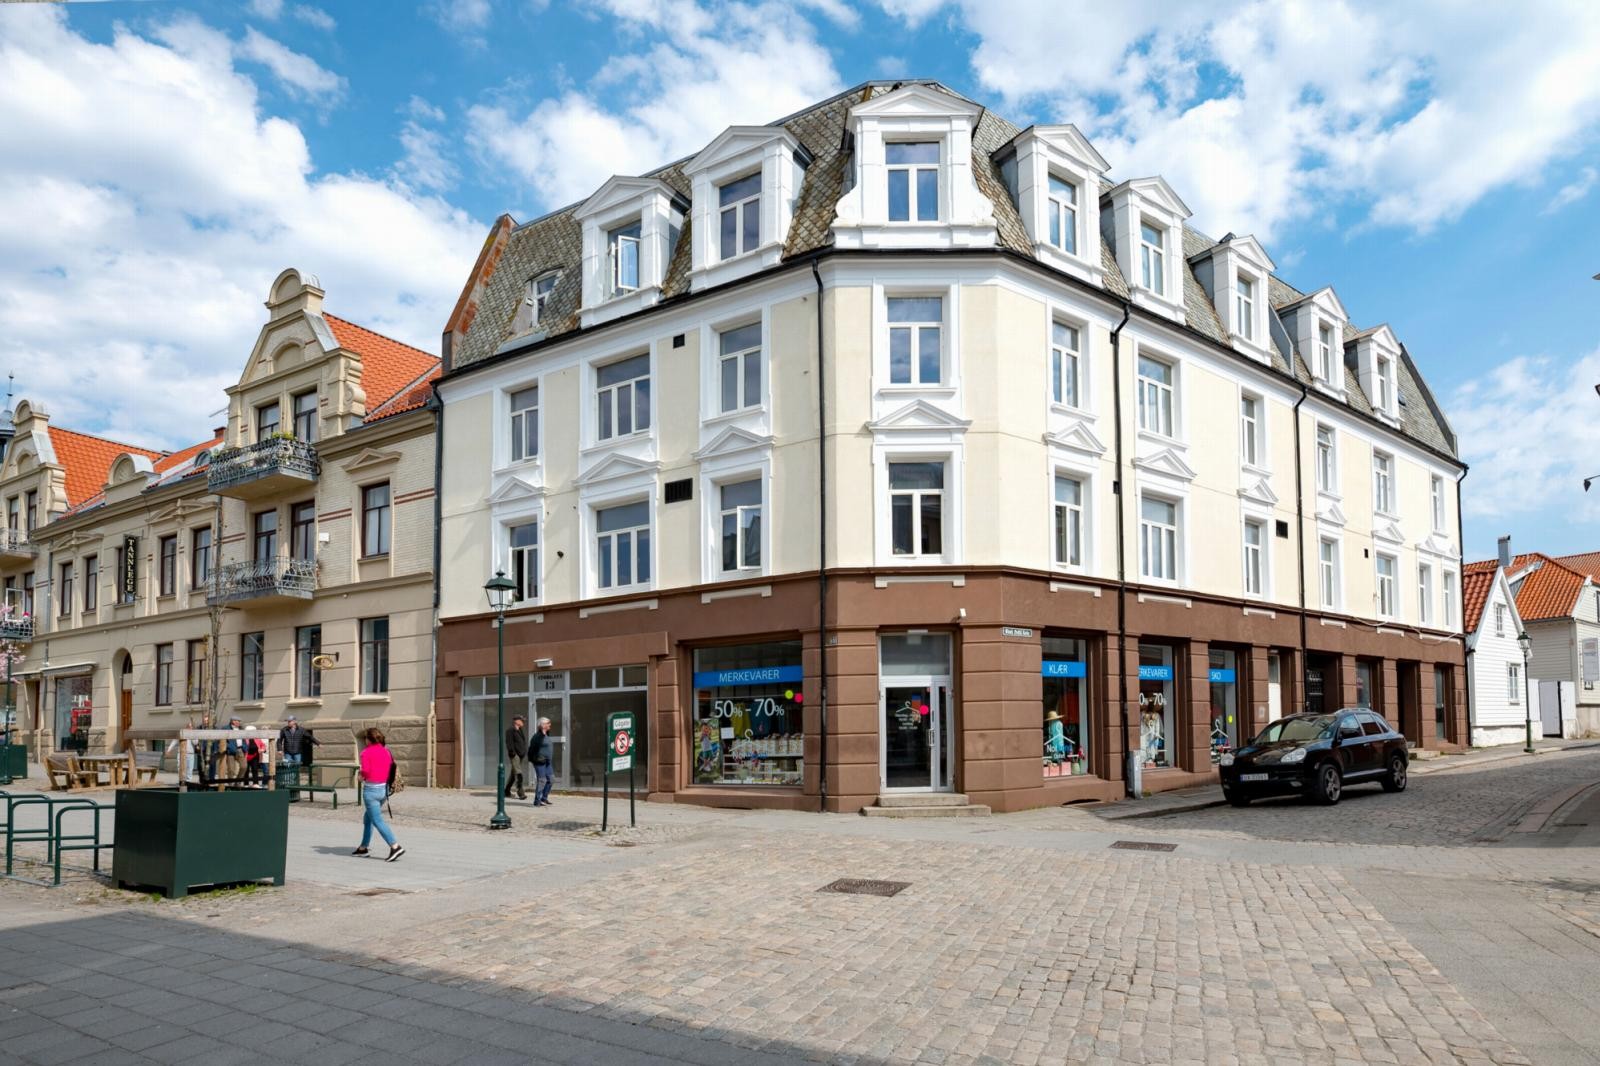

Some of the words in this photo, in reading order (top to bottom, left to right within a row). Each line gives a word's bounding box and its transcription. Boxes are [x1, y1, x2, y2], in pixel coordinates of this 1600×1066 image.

[127, 539, 135, 591] TANNLEGE
[719, 669, 780, 683] MERKEVARER
[1049, 664, 1068, 674] KLÆR
[1139, 667, 1168, 678] ERKEVARER
[714, 700, 743, 718] 50%
[754, 698, 784, 717] 70%
